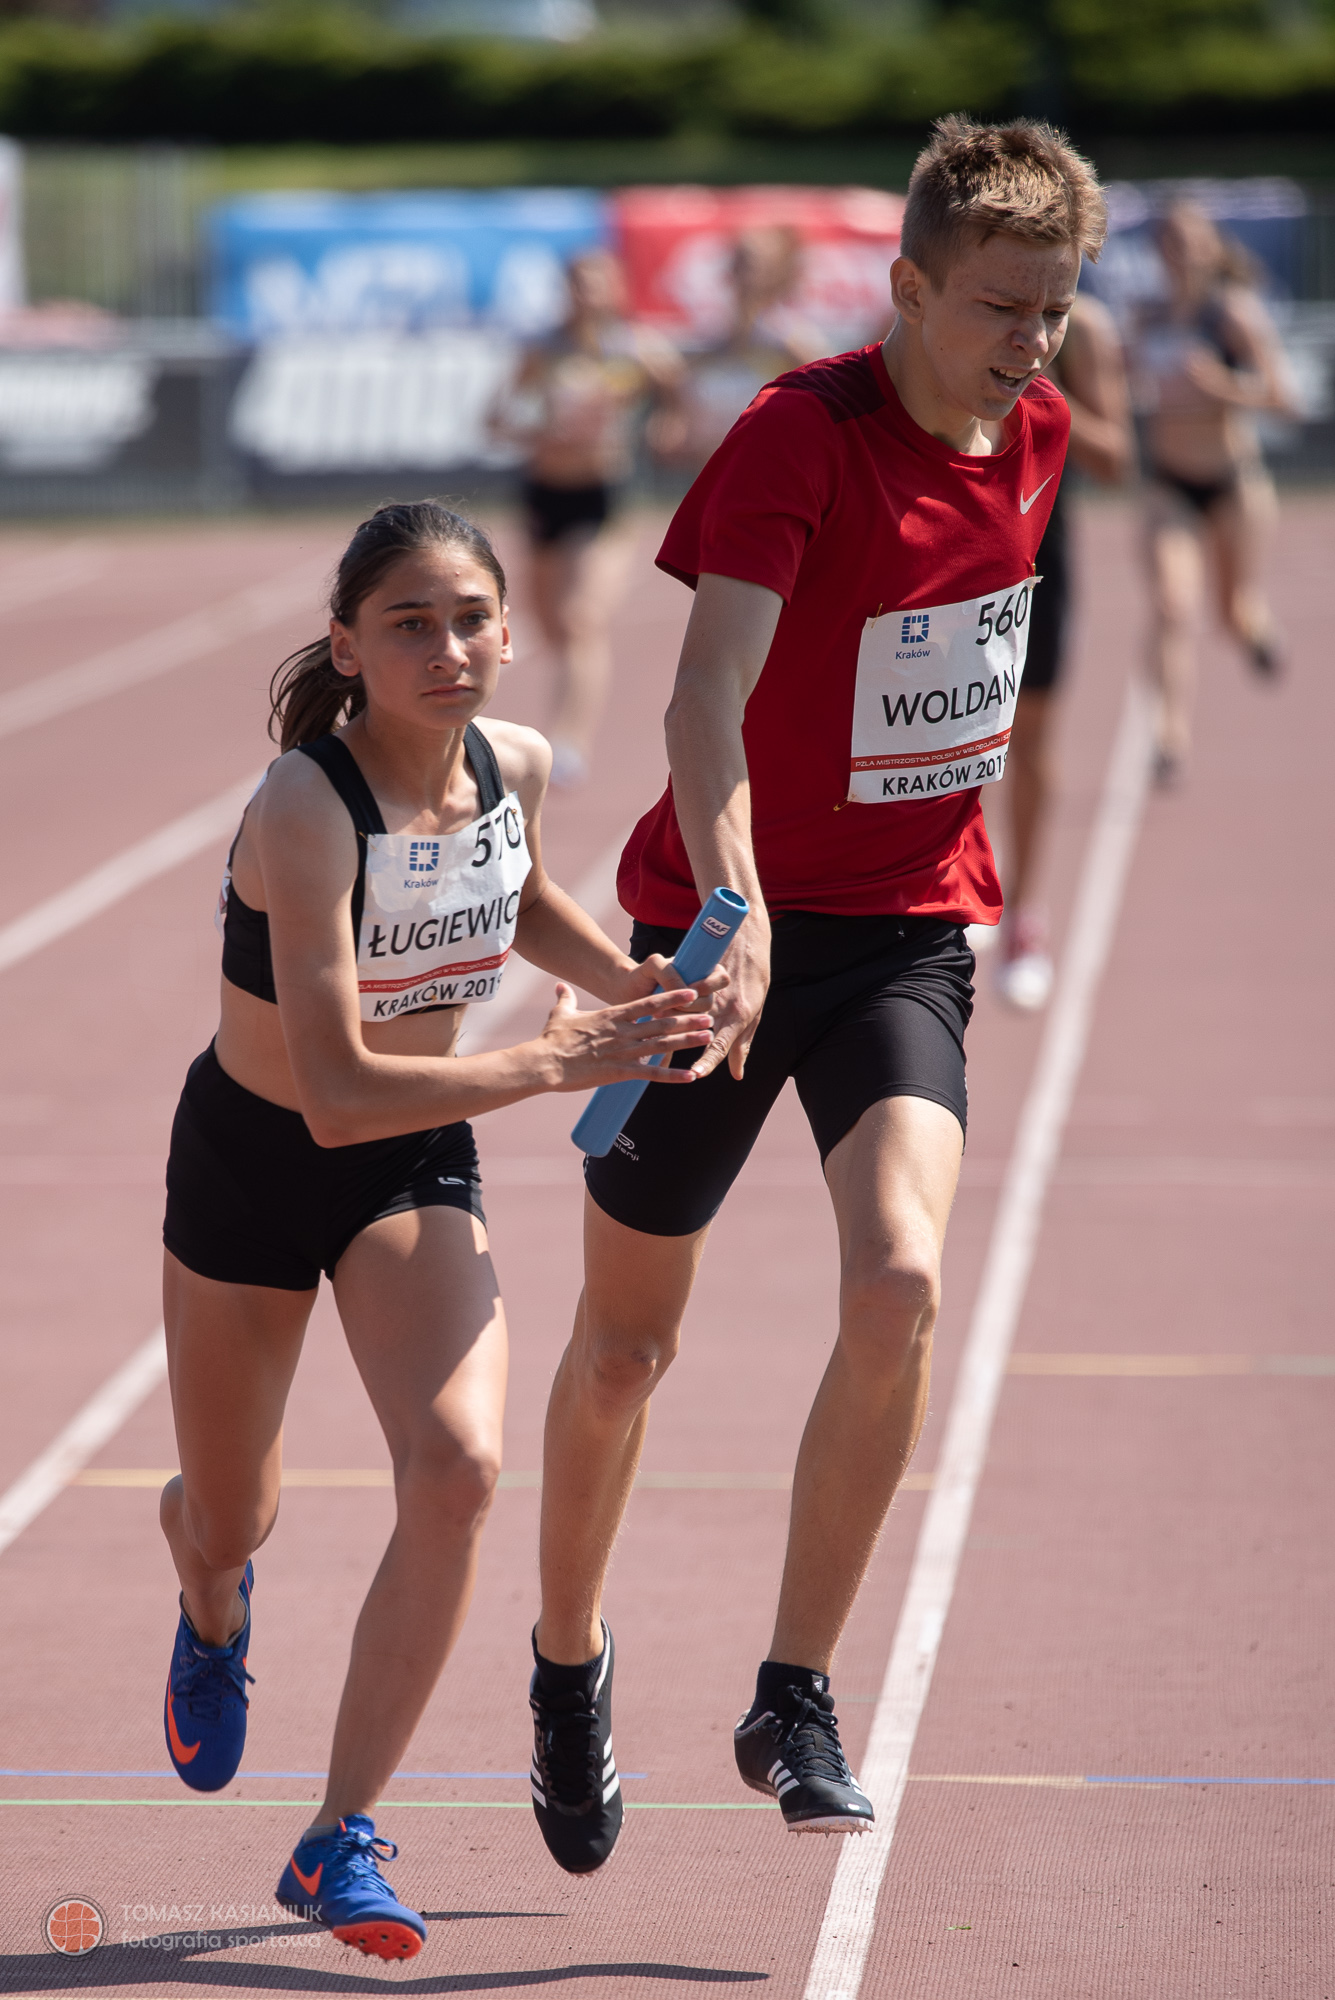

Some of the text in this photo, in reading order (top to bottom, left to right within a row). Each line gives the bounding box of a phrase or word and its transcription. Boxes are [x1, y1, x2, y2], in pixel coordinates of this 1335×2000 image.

[975, 586, 1028, 646] 560
[895, 648, 931, 660] Kraków
[881, 664, 1016, 727] WOLDAN
[882, 764, 972, 796] KRAKÓW
[471, 806, 521, 868] 570
[404, 877, 439, 889] Kraków
[373, 980, 459, 1016] KRAKÓW
[613, 1140, 640, 1161] alenji
